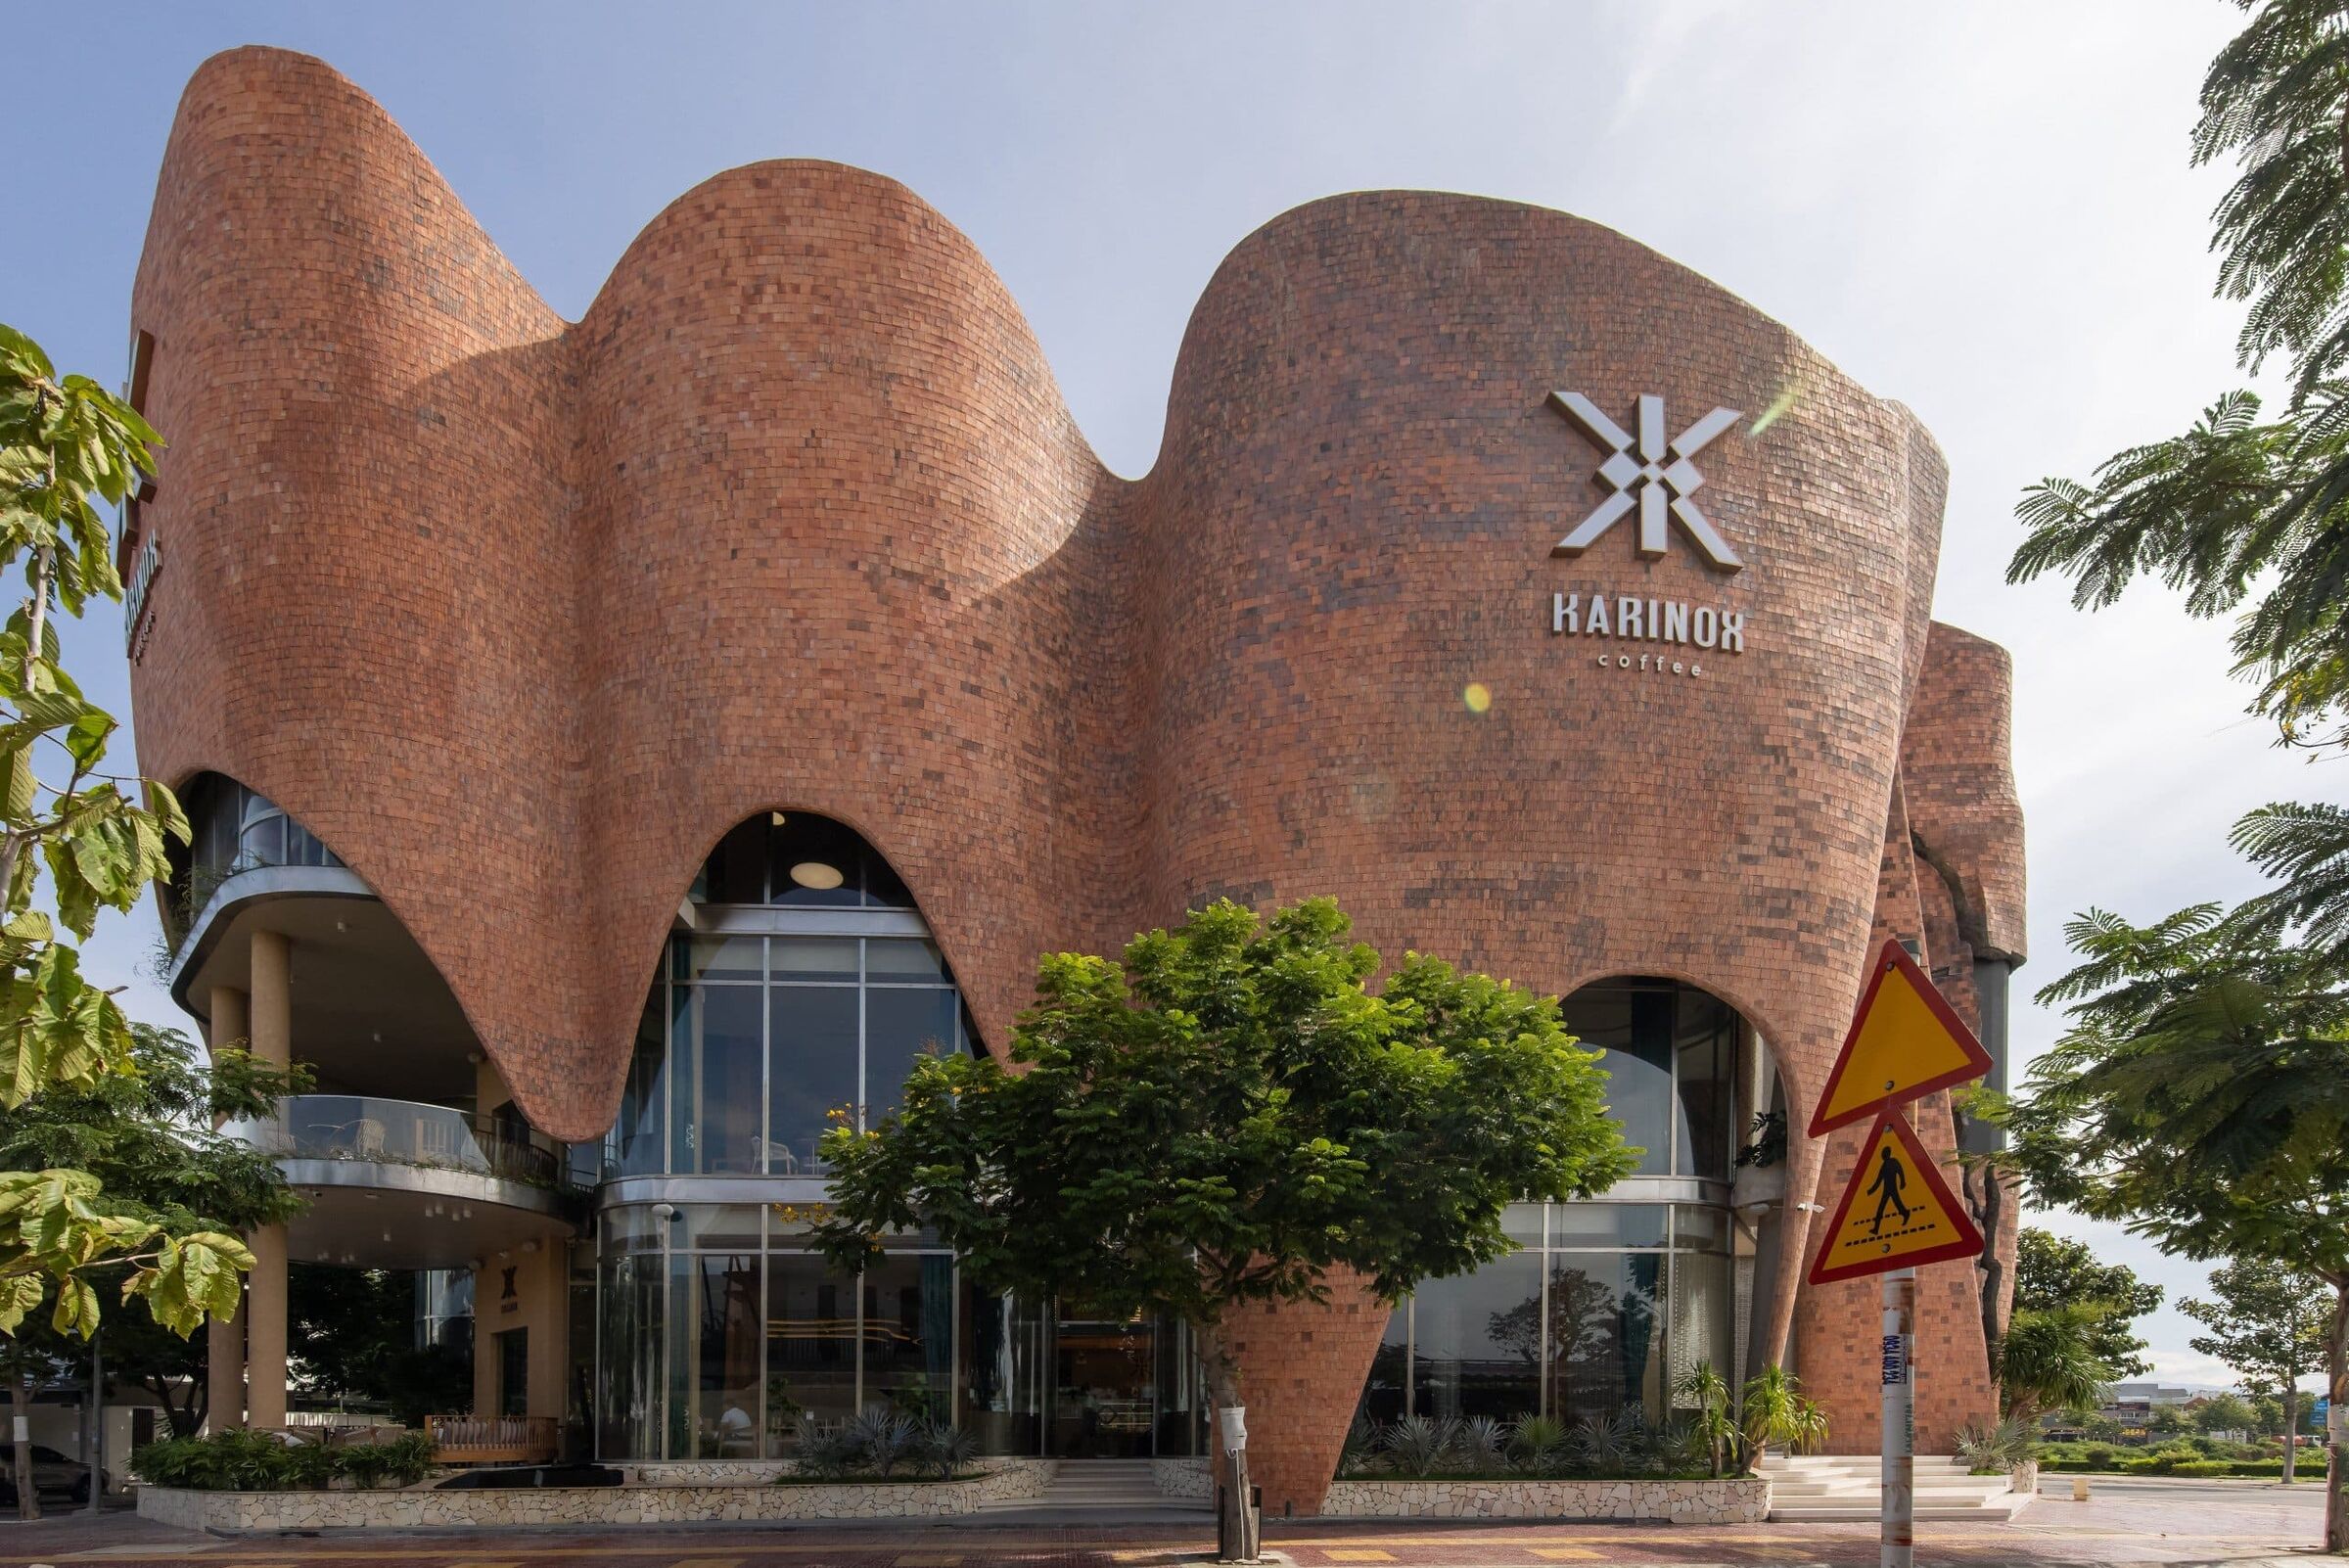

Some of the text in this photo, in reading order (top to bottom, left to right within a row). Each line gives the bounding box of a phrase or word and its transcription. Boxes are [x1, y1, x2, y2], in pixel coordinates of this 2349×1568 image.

[124, 529, 158, 656] ARINOX
[1552, 592, 1744, 653] KARINOX
[1597, 653, 1702, 677] coffee
